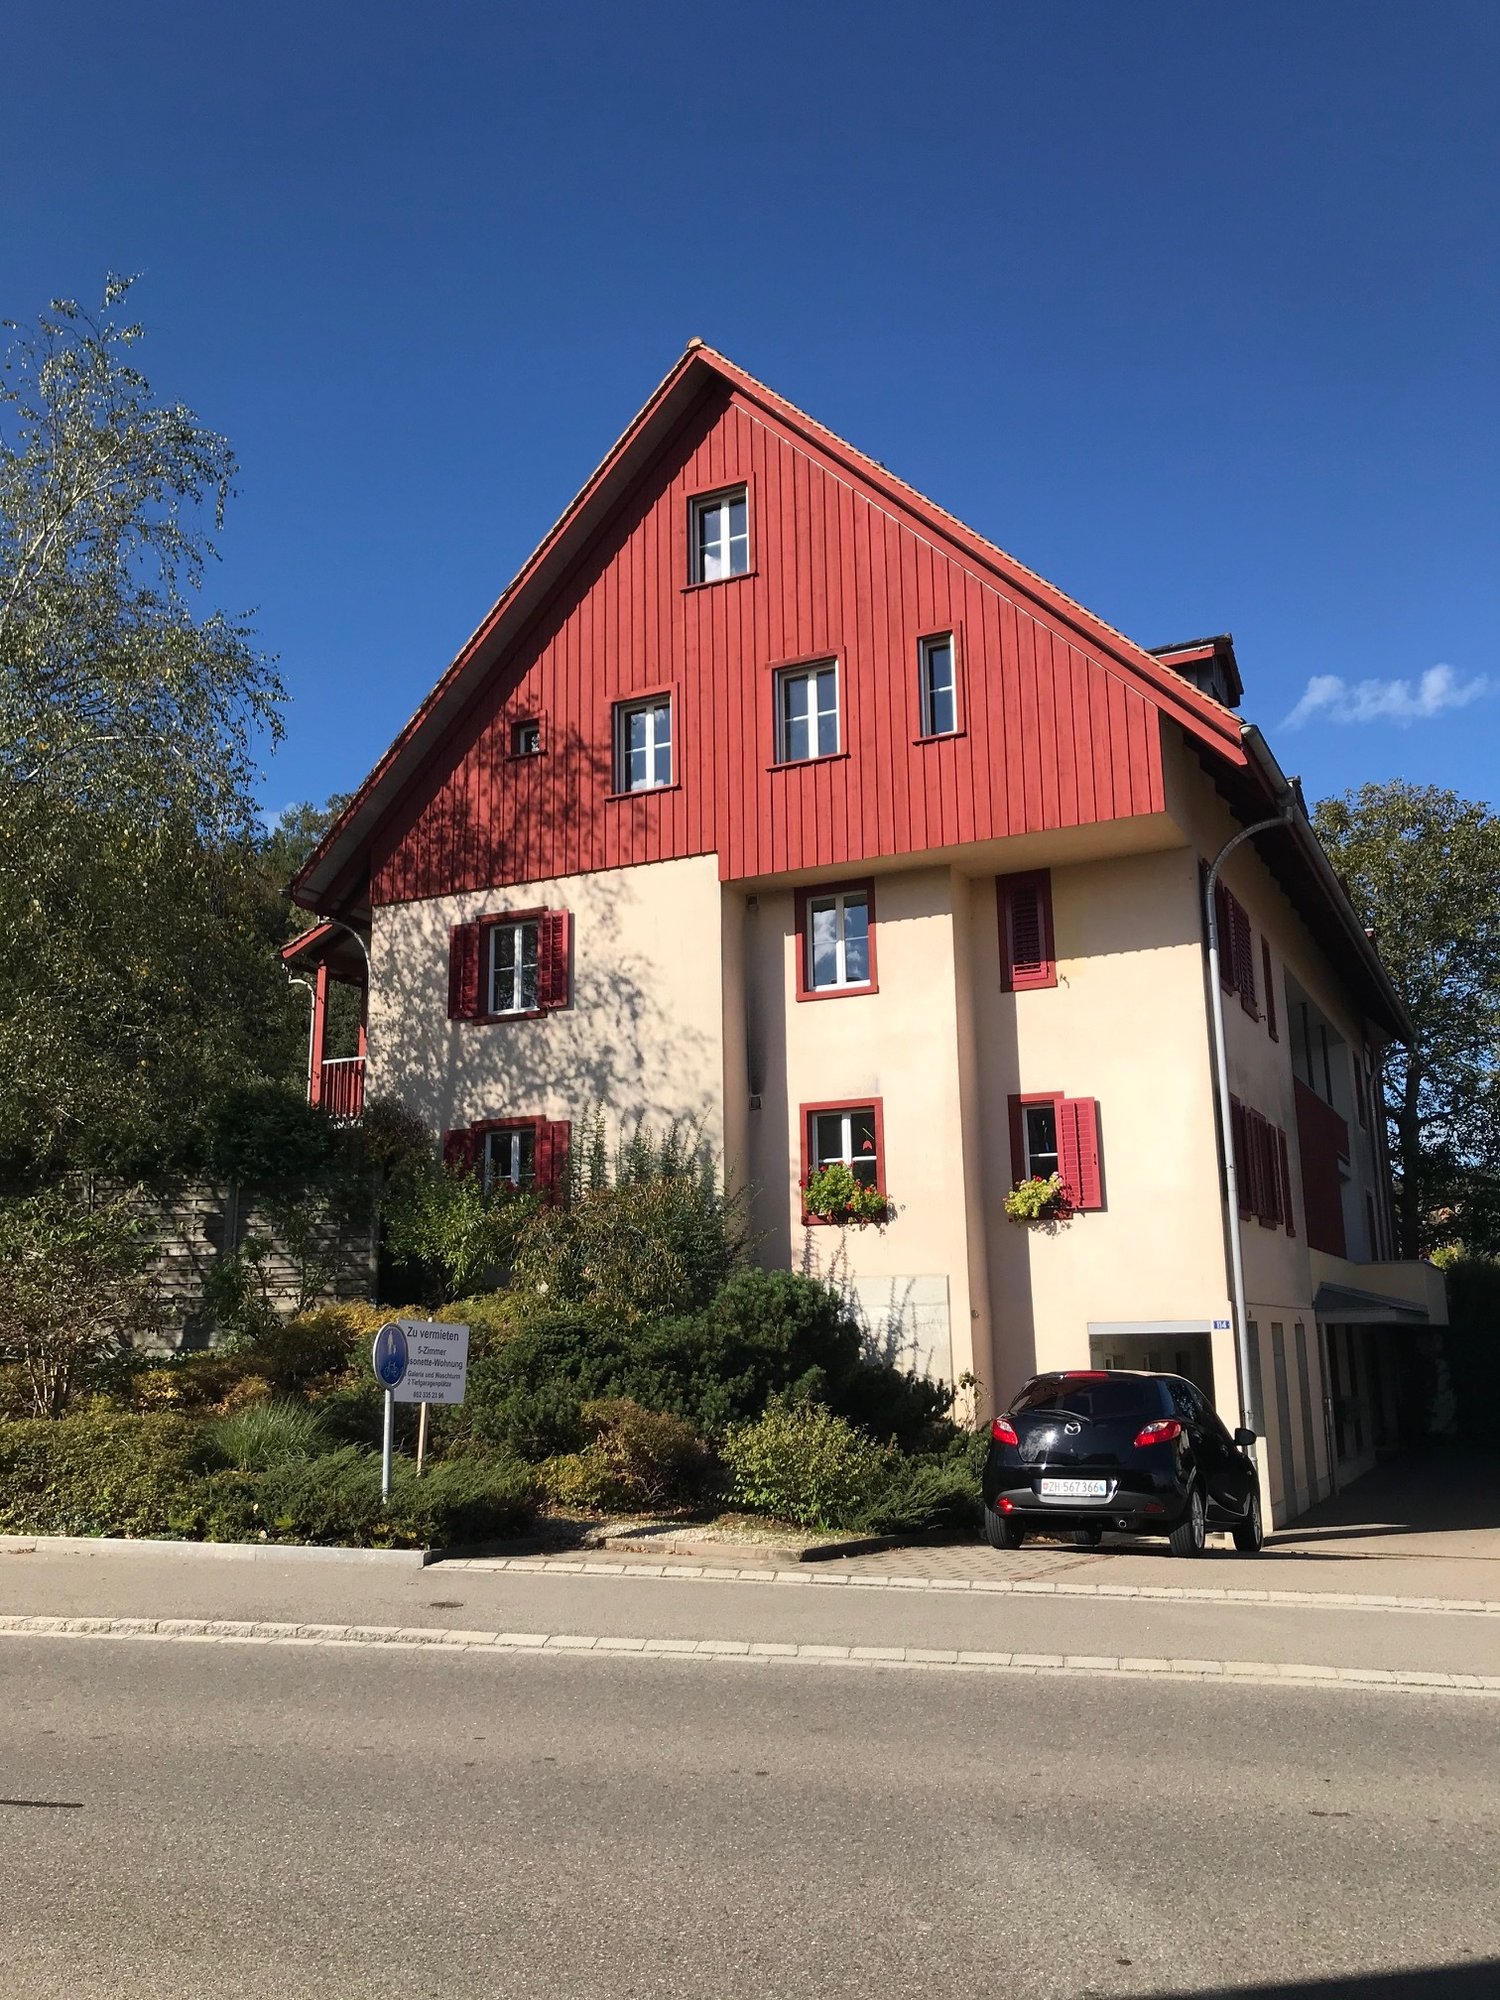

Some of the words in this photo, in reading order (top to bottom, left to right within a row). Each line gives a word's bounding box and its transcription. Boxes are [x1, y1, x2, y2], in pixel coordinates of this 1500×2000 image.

[1216, 1321, 1227, 1329] 114
[407, 1326, 418, 1338] Zu
[420, 1329, 459, 1341] vermieten
[418, 1345, 447, 1356] 5-Zimmer
[409, 1358, 463, 1370] sonette-Wohnung
